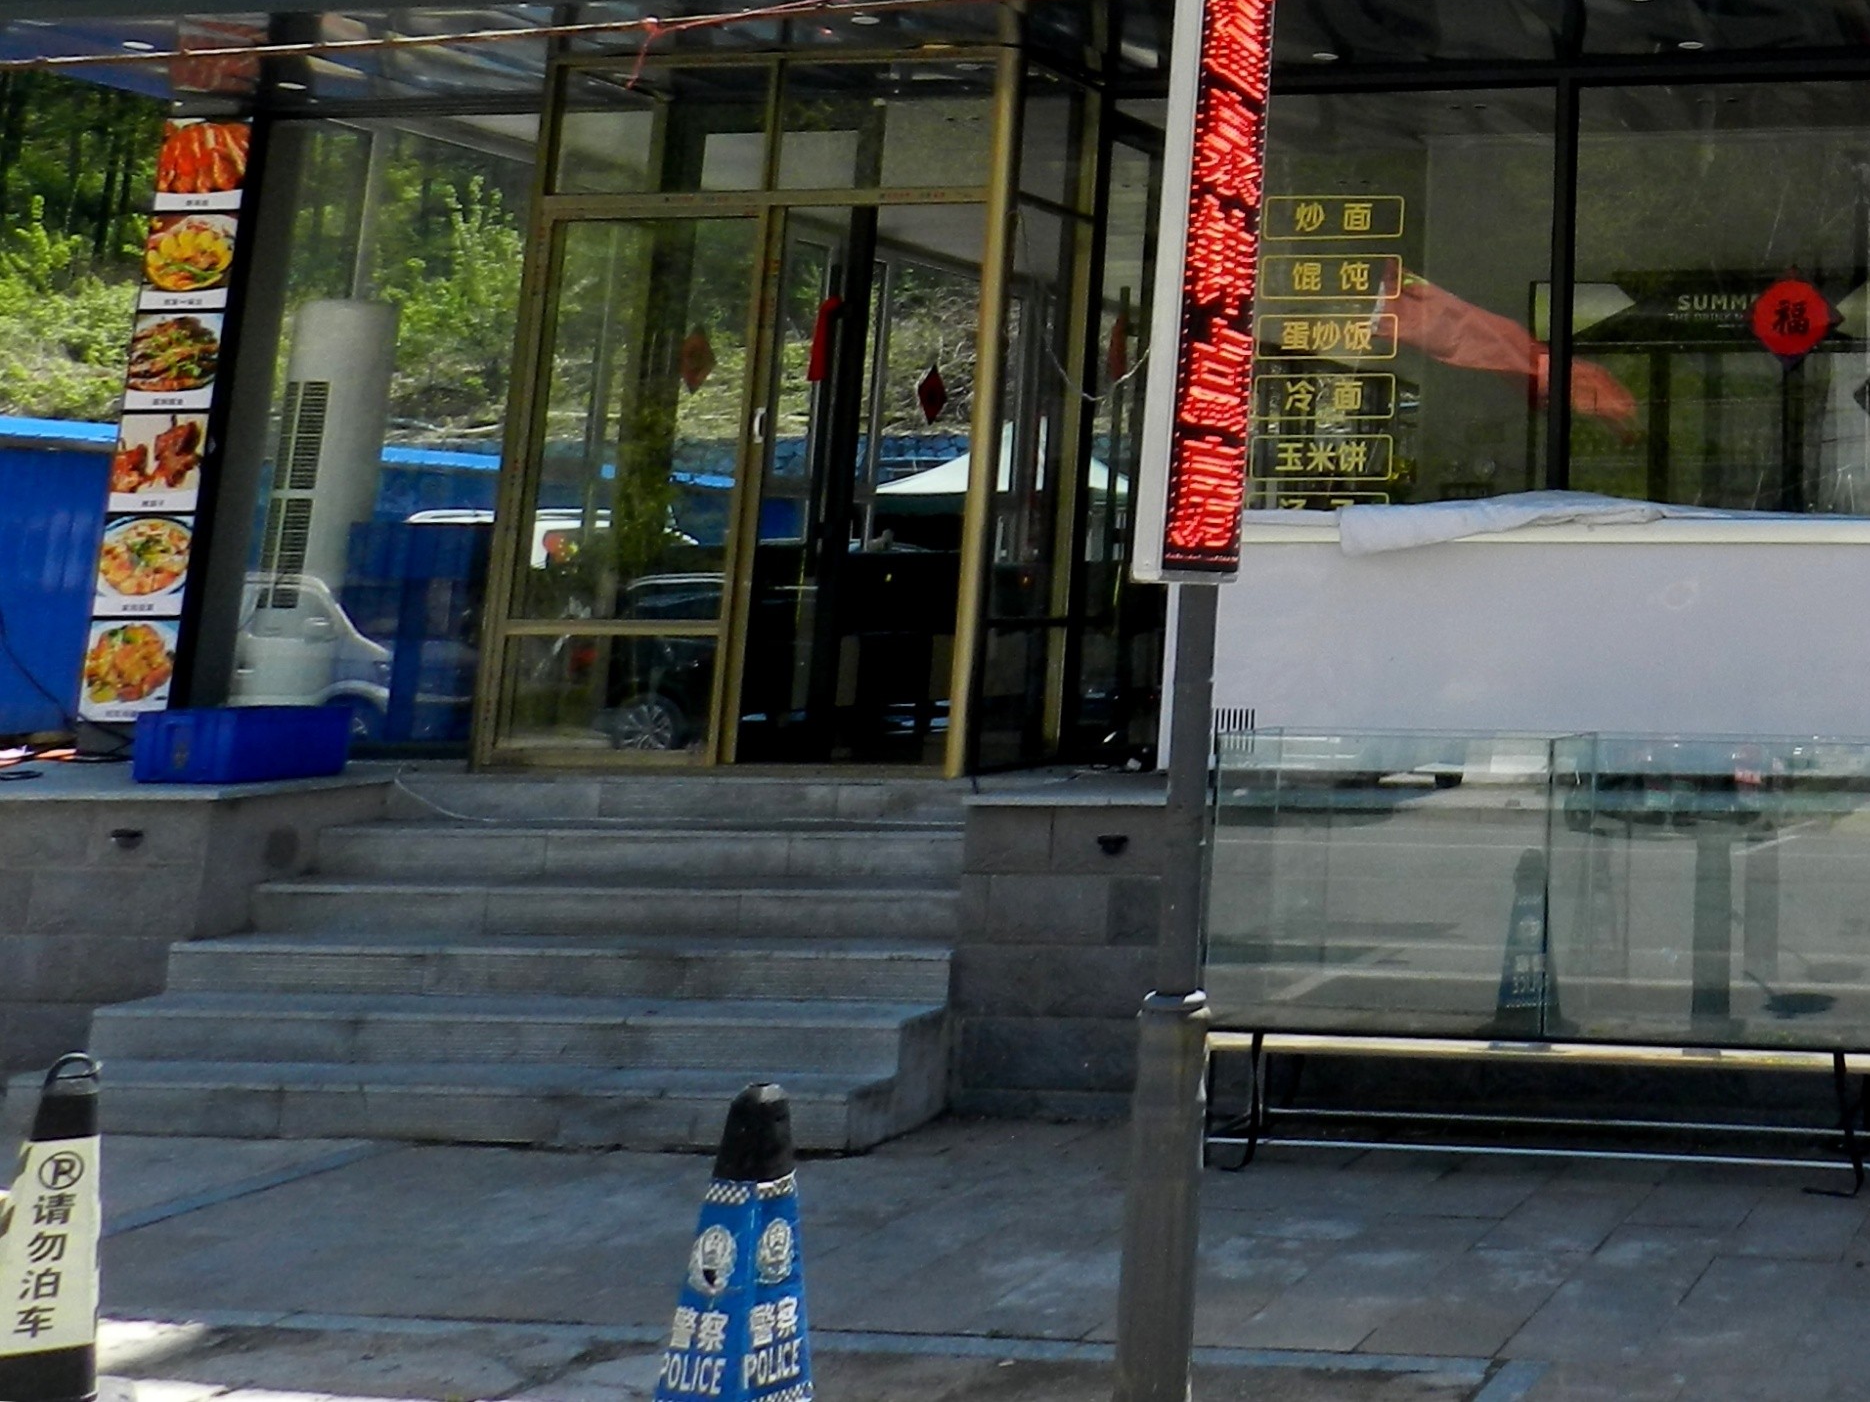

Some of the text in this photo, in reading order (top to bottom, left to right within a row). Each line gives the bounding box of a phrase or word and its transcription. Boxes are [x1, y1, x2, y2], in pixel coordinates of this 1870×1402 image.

[1295, 202, 1373, 232] 炒面
[1292, 262, 1370, 292] 馄饨
[1773, 299, 1811, 335] 福
[1281, 321, 1373, 351] 蛋炒饭
[1285, 380, 1364, 411] 冷面
[1275, 442, 1367, 473] 玉米饼
[13, 1193, 77, 1338] 请勿泊车
[669, 1305, 729, 1352] 警察
[750, 1296, 798, 1347] 警察
[659, 1352, 728, 1395] POLICE
[743, 1337, 804, 1390] POLICE
